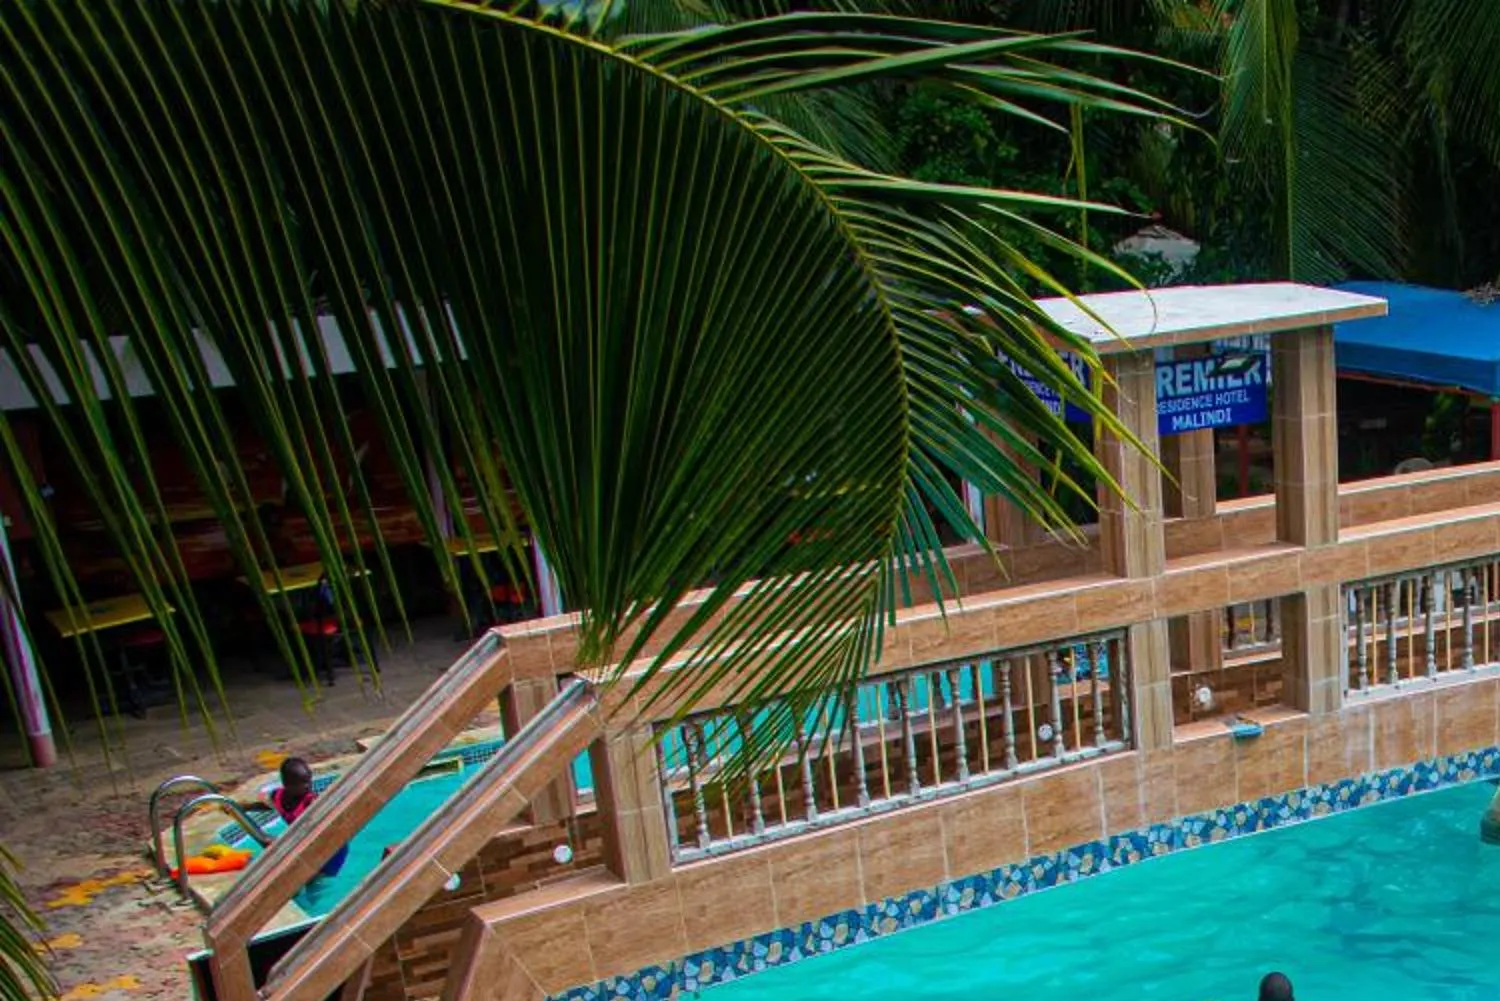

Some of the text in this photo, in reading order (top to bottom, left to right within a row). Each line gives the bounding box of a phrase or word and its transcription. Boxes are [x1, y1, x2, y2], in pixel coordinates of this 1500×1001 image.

[1157, 389, 1250, 414] ESIDENCE HOTEL
[1172, 407, 1232, 431] MALINDI
